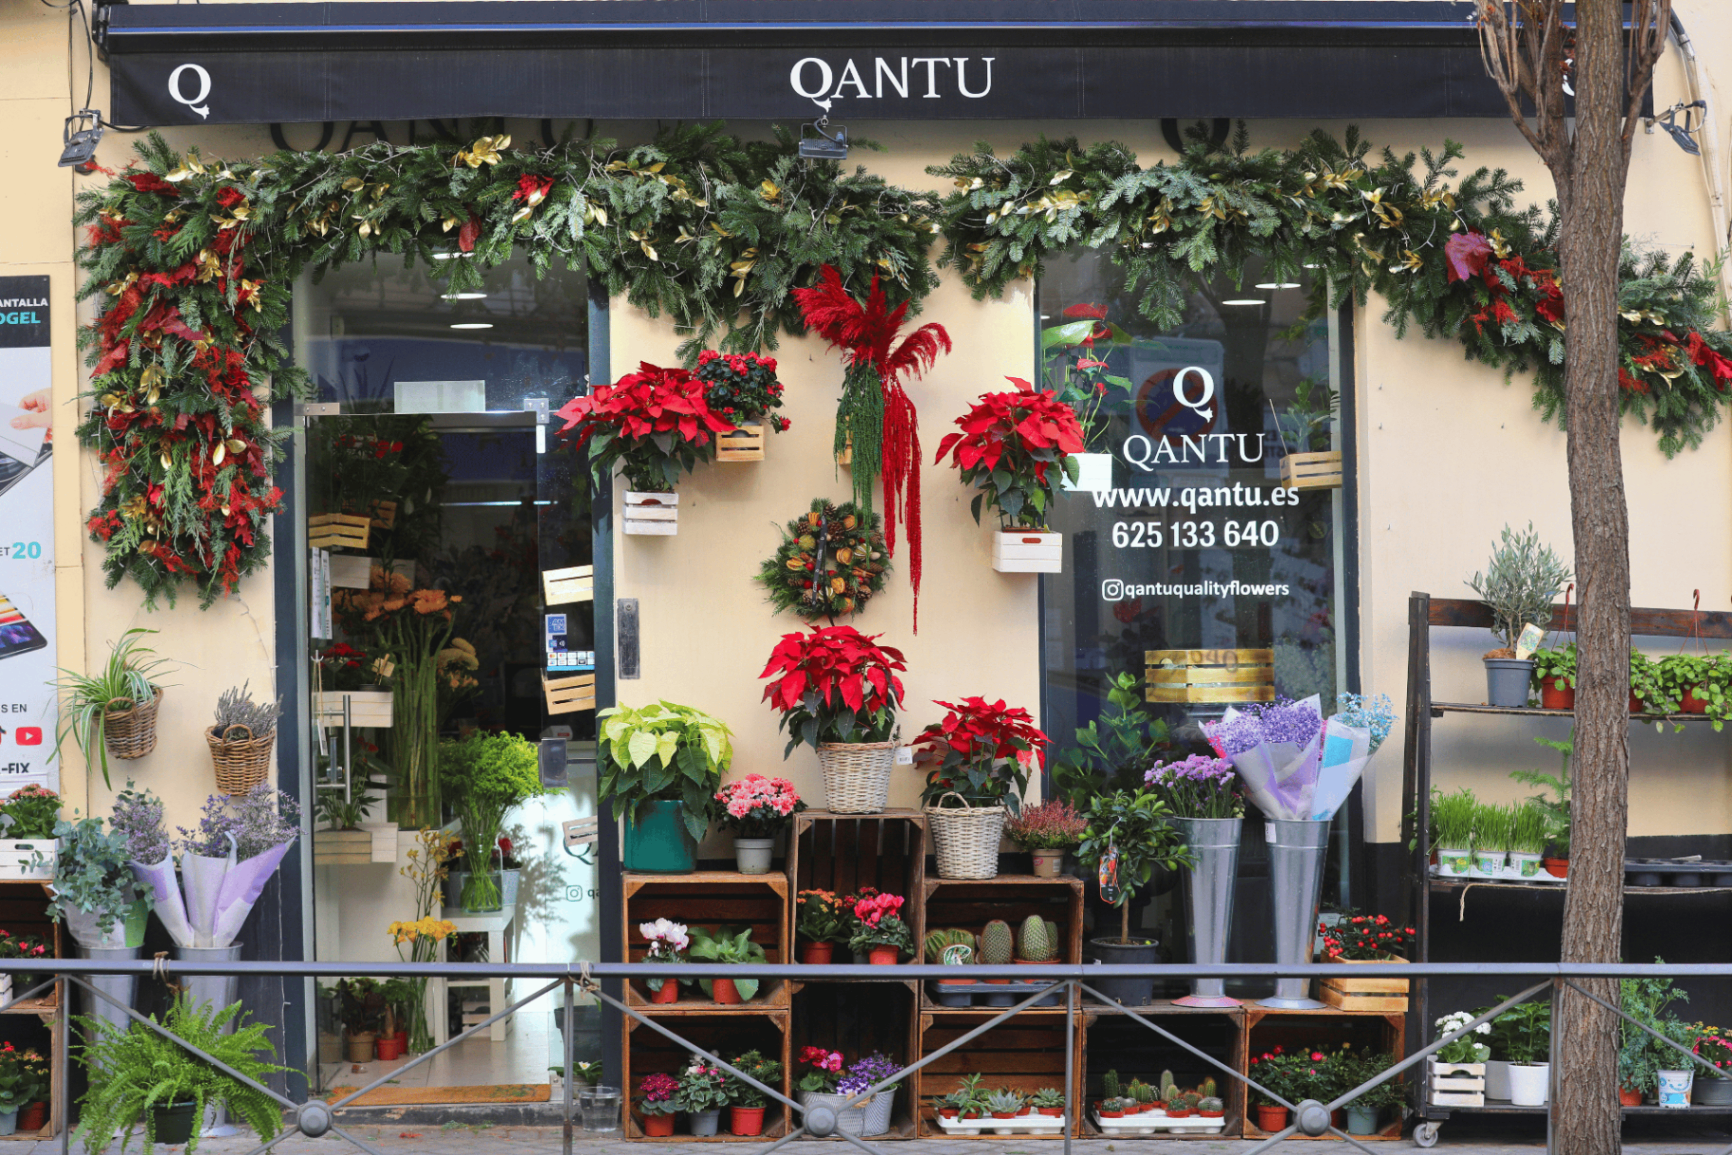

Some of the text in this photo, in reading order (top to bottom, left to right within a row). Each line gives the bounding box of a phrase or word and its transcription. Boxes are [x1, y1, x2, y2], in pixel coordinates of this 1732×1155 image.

[168, 63, 211, 120] Q
[789, 56, 996, 113] QANTU
[1172, 365, 1215, 423] Q
[1122, 433, 1266, 472] QANTU
[1092, 481, 1300, 515] www.qantu.es
[12, 541, 42, 559] 20
[1111, 520, 1280, 549] 625 133 640
[1125, 580, 1290, 599] qantuqualityflowers
[12, 703, 27, 713] EN
